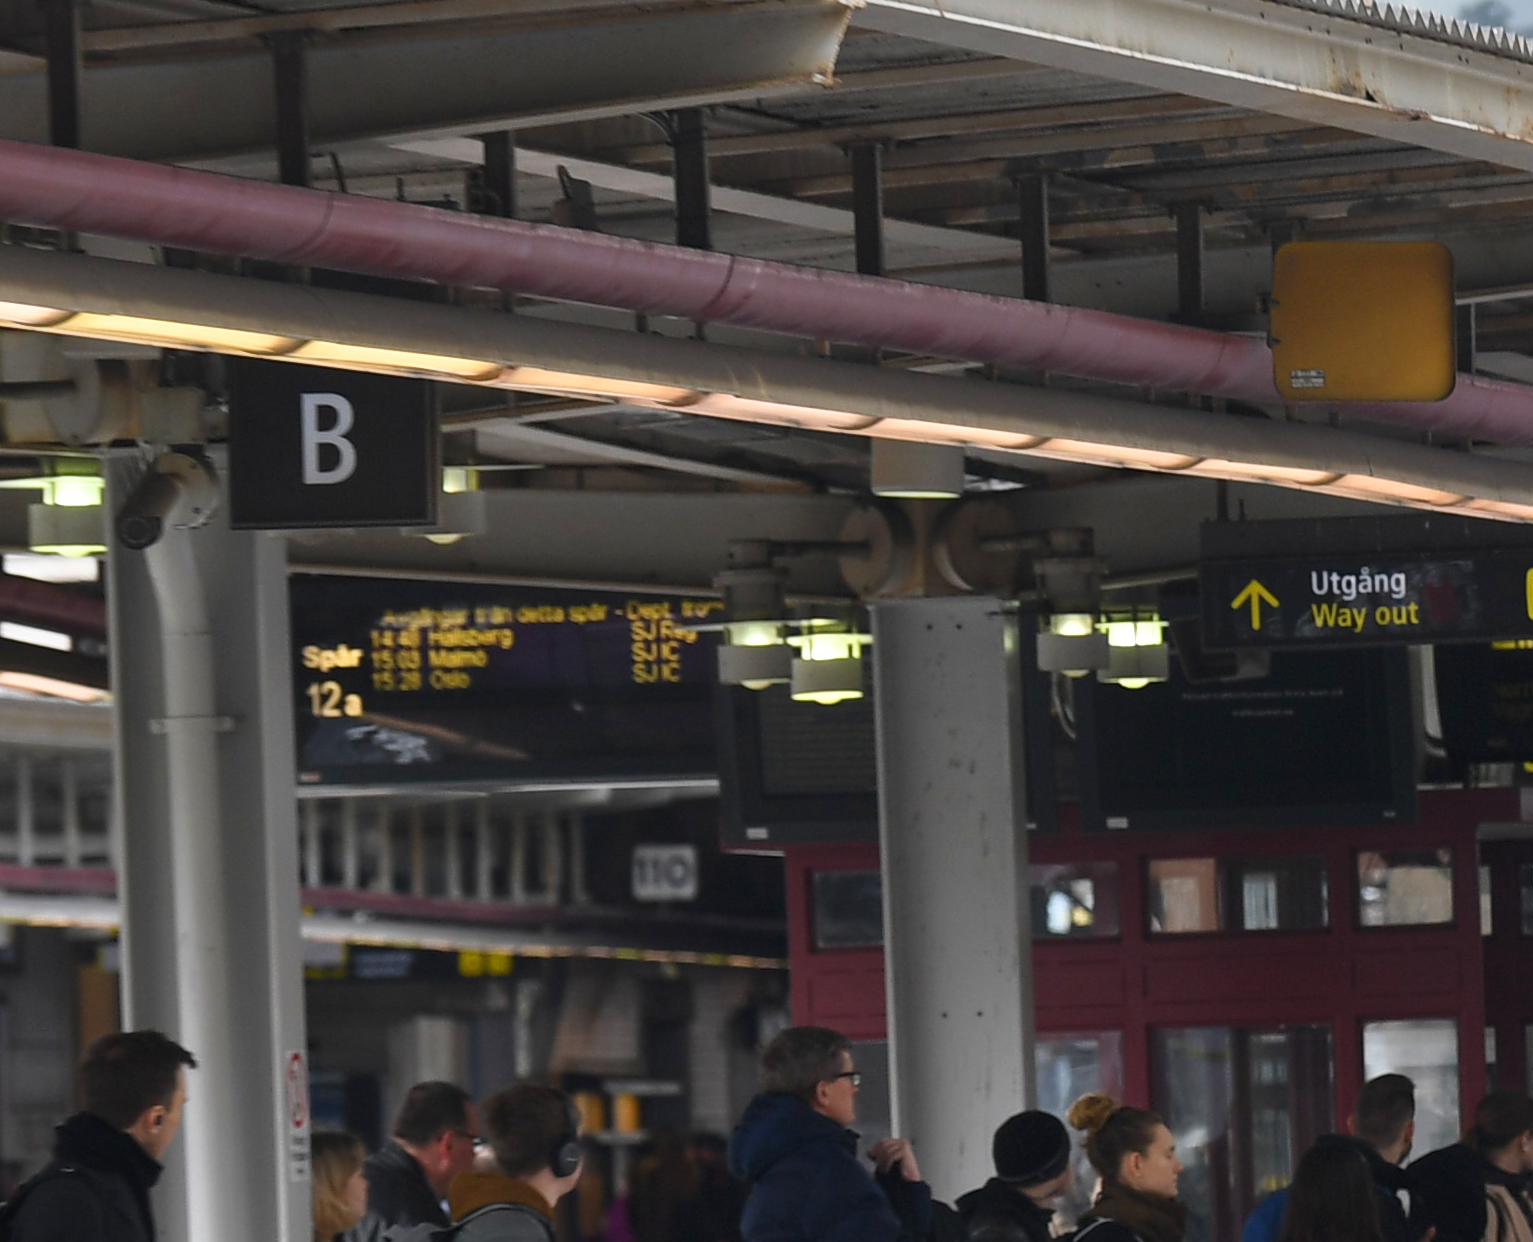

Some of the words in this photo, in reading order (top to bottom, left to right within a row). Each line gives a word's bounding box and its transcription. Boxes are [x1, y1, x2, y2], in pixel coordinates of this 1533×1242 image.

[300, 393, 357, 485] B
[1311, 566, 1406, 601] Utgång
[1311, 603, 1367, 633] Way
[1375, 602, 1419, 626] out
[302, 644, 364, 673] Spår
[428, 648, 489, 668] Malmö
[429, 670, 471, 690] Oslo
